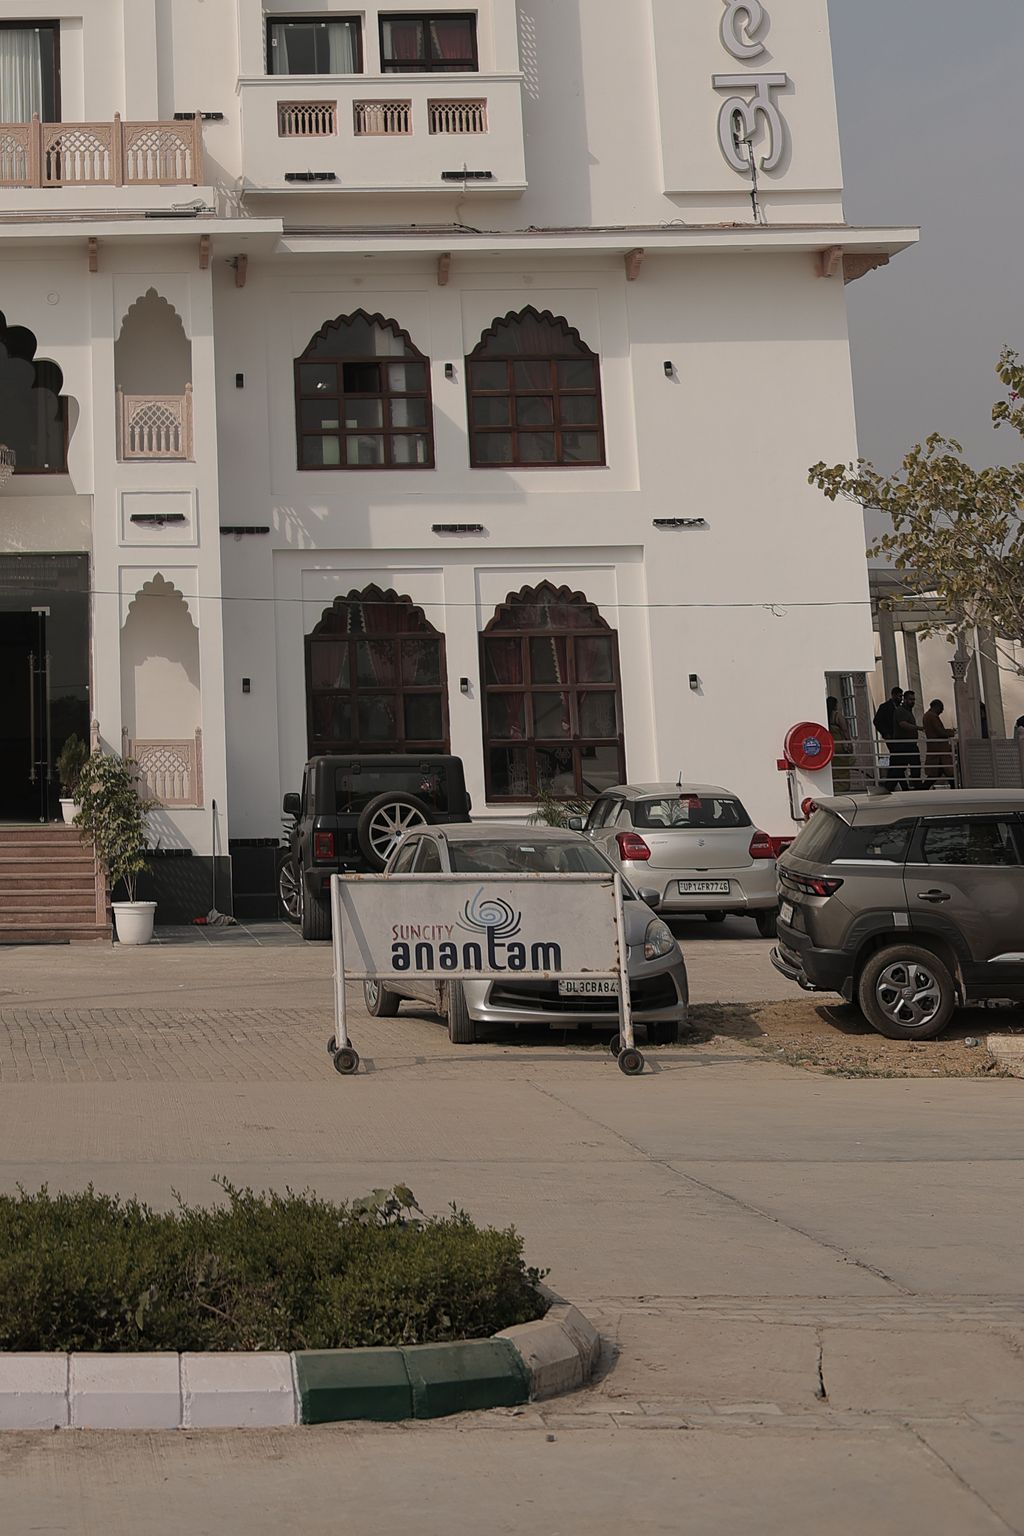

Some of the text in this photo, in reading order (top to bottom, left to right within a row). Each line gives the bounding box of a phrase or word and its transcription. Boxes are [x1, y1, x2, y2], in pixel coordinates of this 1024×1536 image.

[682, 882, 728, 892] UP14FR7746
[391, 924, 455, 942] SUNCITY
[391, 925, 562, 971] anantam
[565, 981, 619, 993] DL3CBA84
